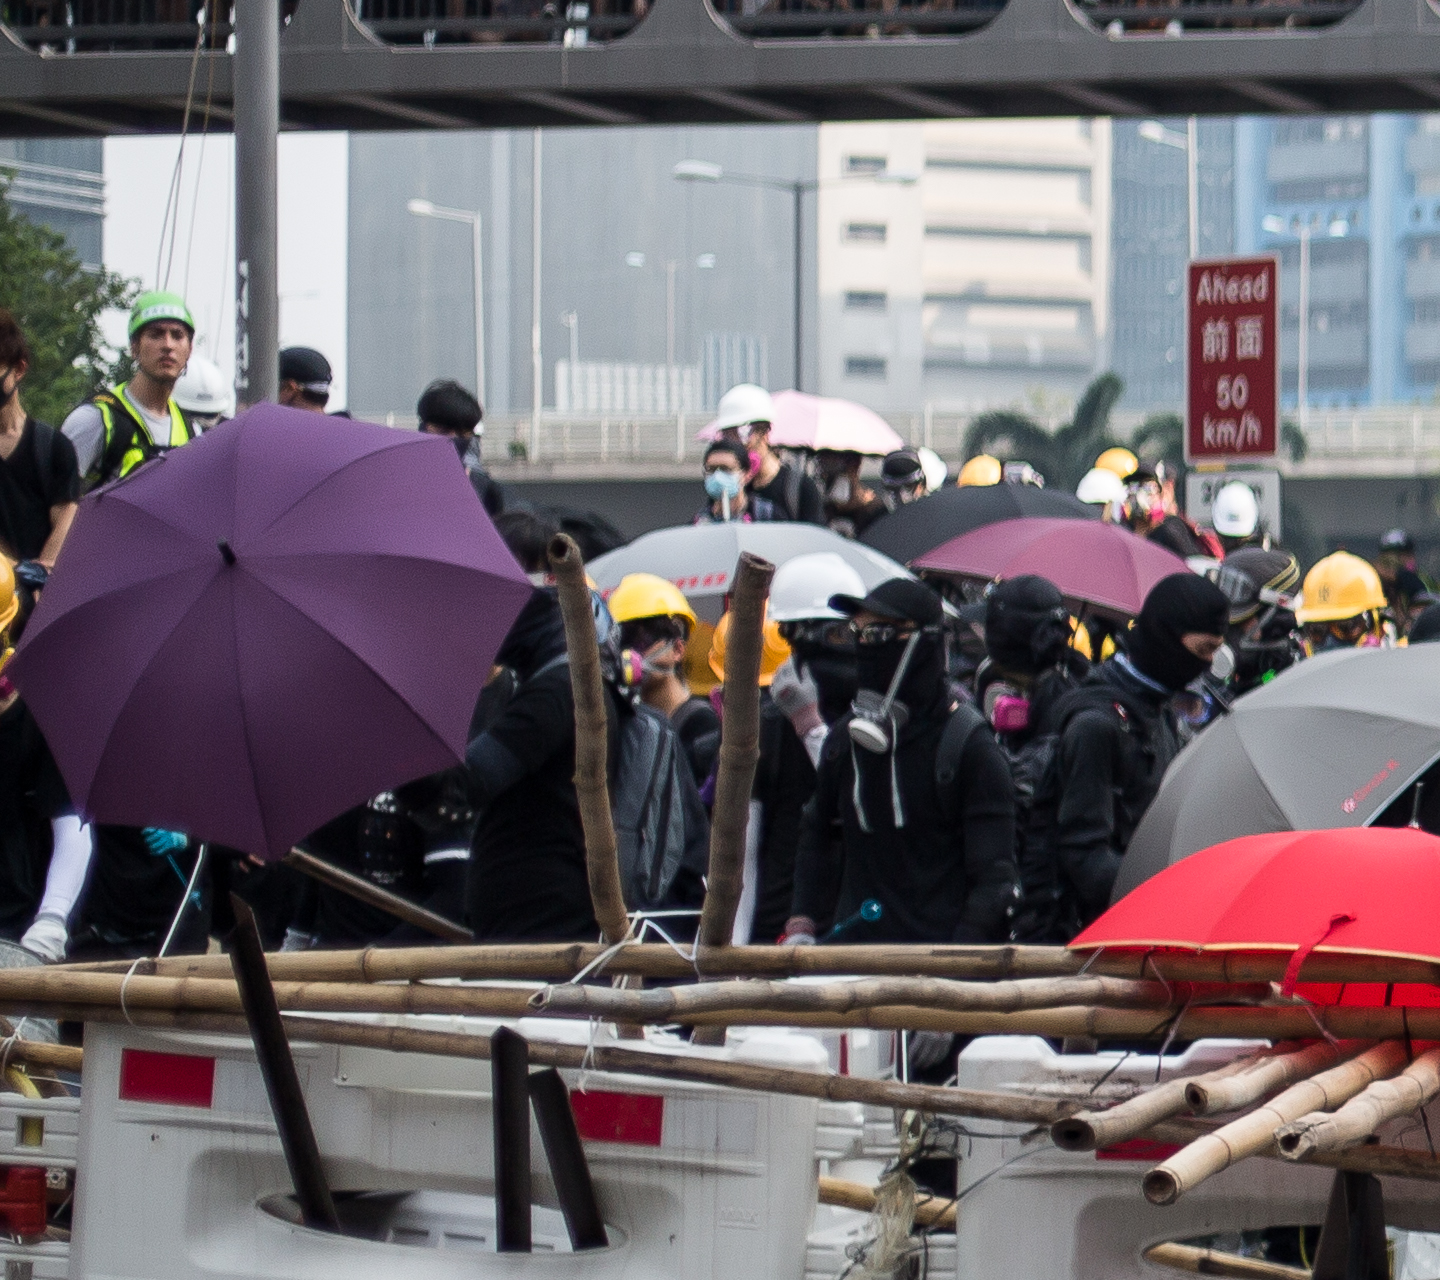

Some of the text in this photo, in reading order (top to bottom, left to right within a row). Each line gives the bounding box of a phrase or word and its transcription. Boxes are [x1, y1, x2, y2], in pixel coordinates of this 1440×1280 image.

[1197, 266, 1269, 305] Ahead
[1202, 316, 1263, 362] 前面
[1216, 374, 1249, 410] 50
[1203, 411, 1262, 452] km/h
